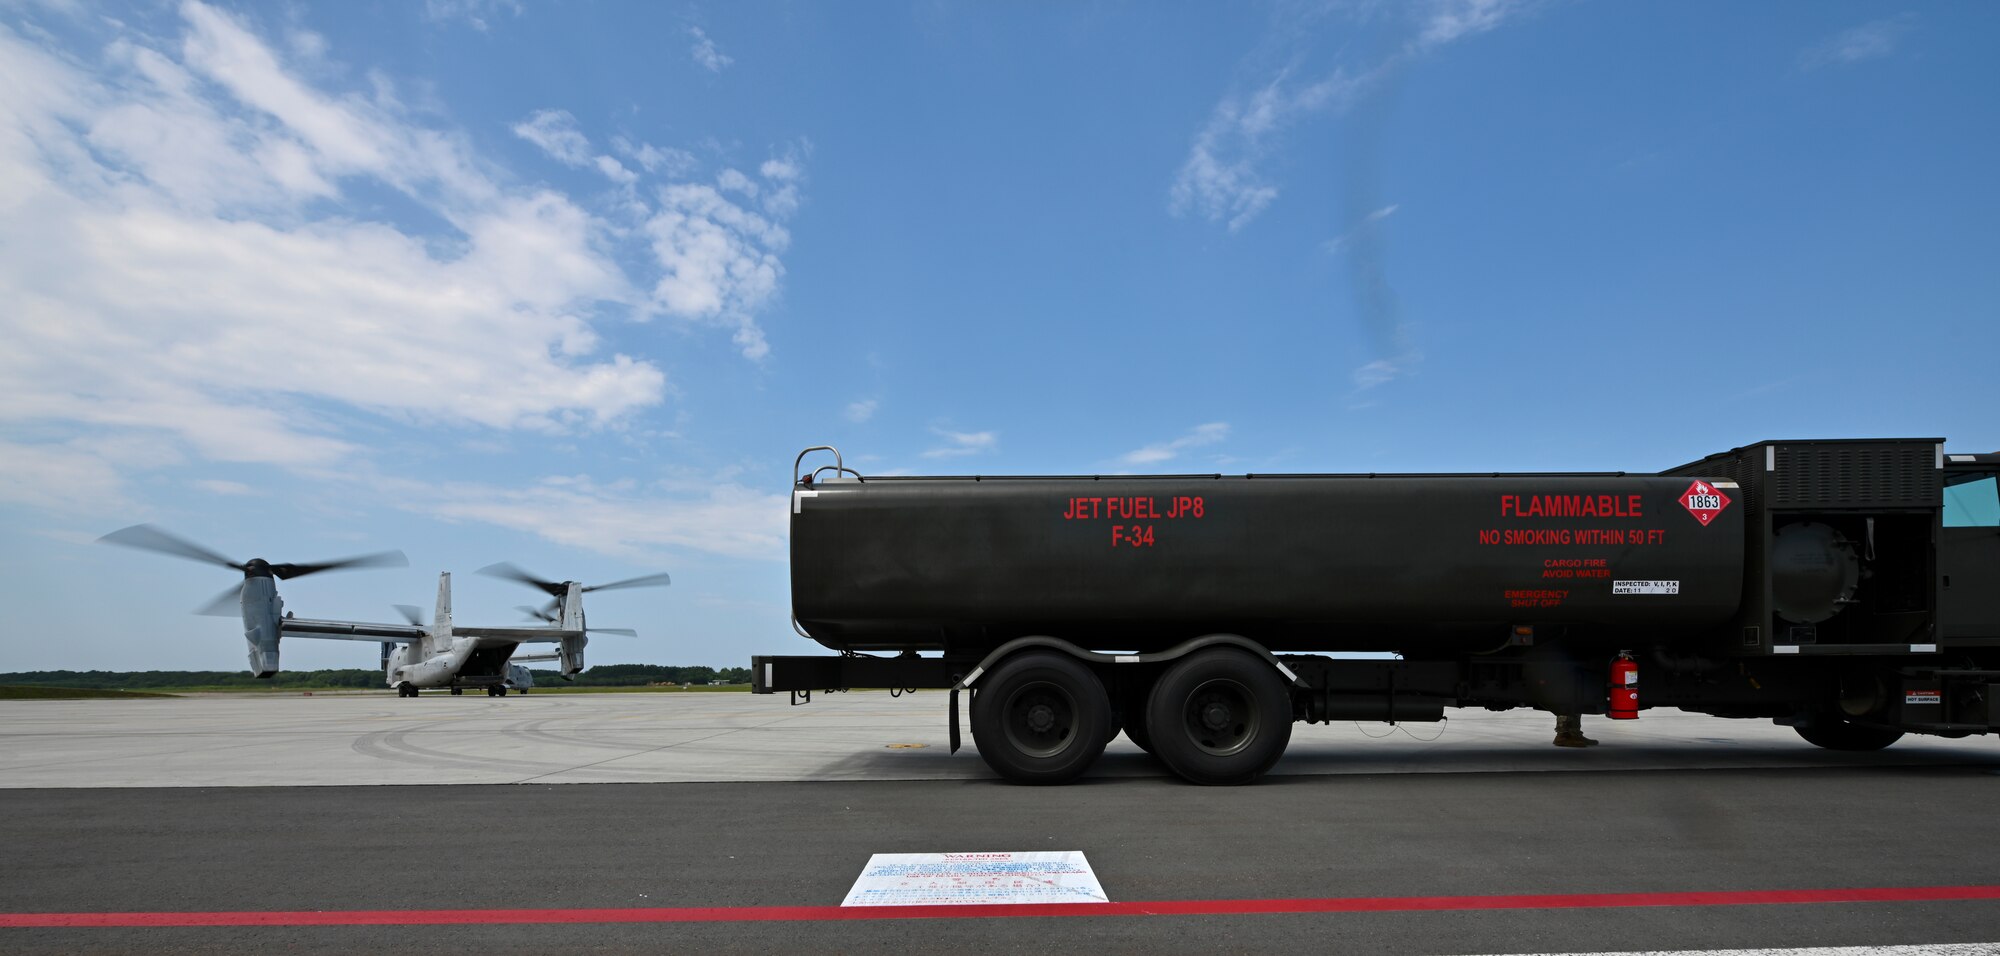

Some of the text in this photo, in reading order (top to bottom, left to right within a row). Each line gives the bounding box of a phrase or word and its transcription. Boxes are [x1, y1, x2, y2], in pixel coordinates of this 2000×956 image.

[1501, 495, 1643, 518] FLAMMABLE
[1690, 495, 1719, 508] 1863
[1064, 496, 1205, 520] JET FUEL JP8
[1702, 513, 1708, 521] 3
[1112, 525, 1155, 548] F-34
[1480, 529, 1665, 546] NO SMOKING WITHIN 50 FT
[1544, 558, 1607, 568] CARGO FIRE
[1543, 569, 1611, 579] AVOID WATER
[1504, 590, 1569, 600] EMERGENCY
[1511, 599, 1563, 609] SHUT OFF
